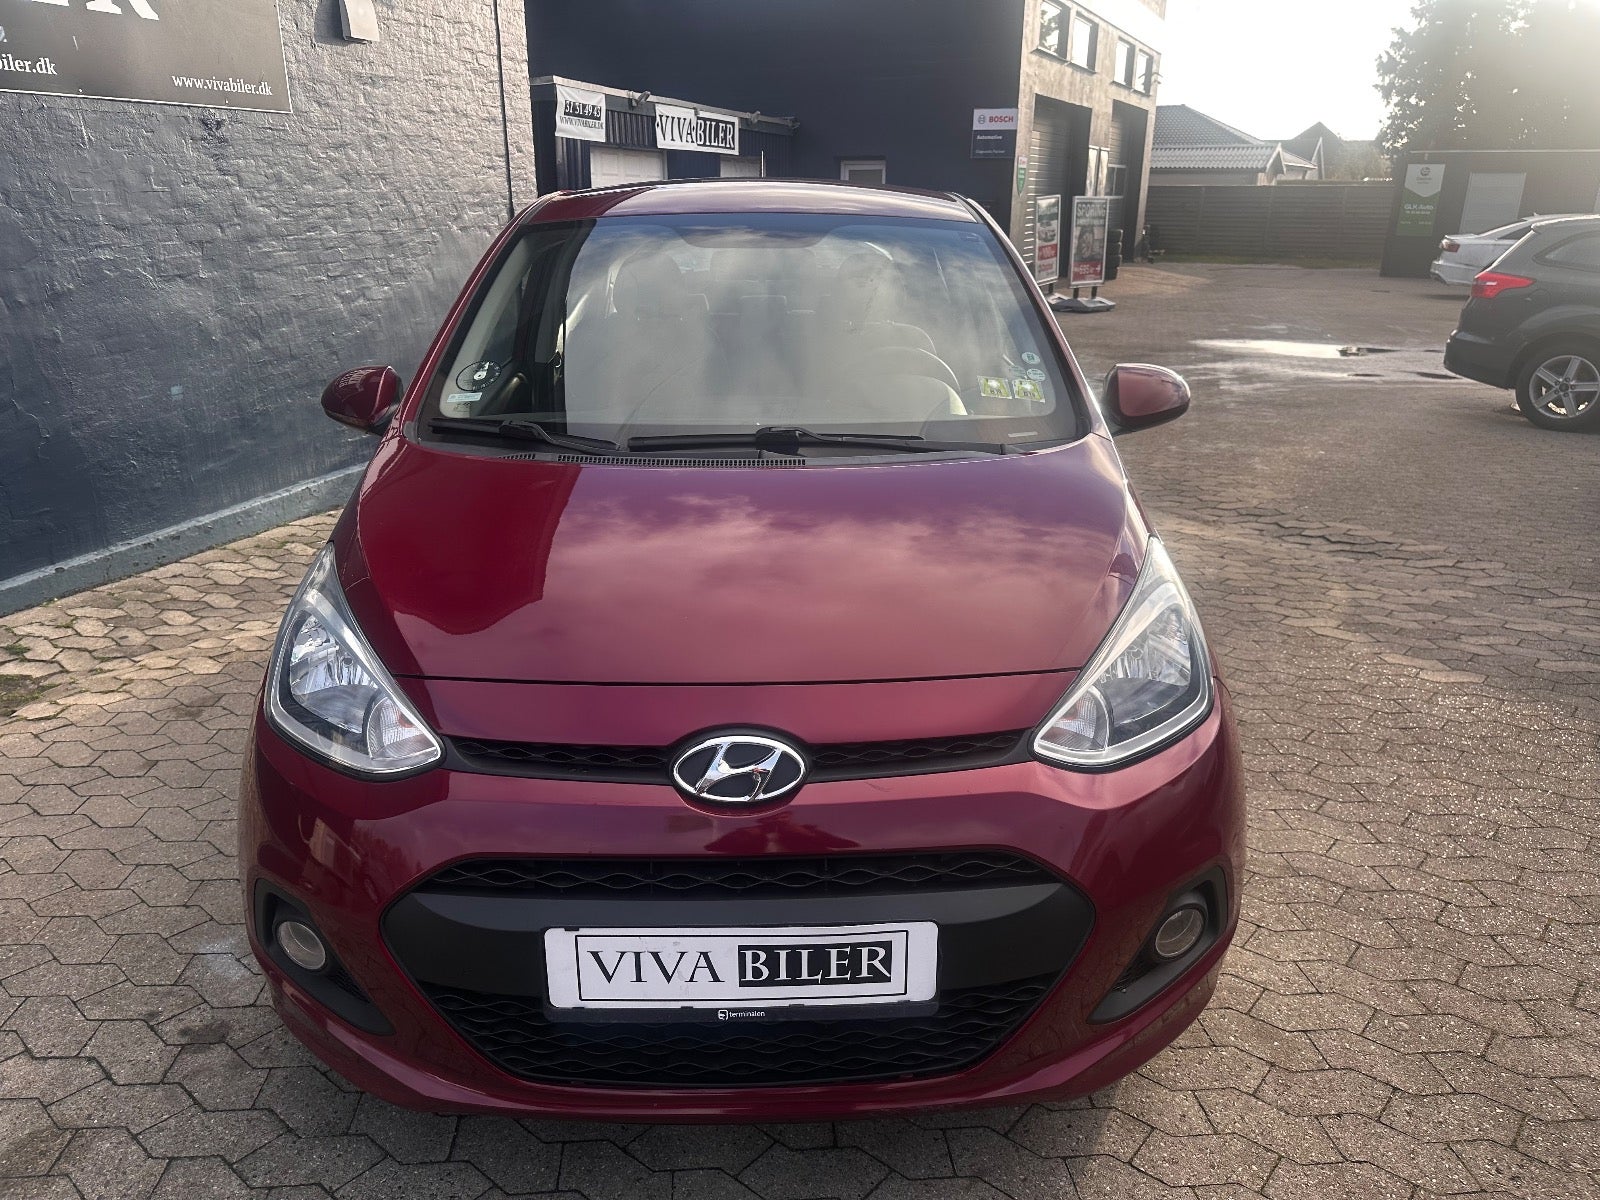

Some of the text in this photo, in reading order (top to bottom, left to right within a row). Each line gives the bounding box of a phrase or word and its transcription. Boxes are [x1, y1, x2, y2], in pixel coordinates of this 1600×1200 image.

[172, 76, 272, 96] www.vivabiler.dk
[989, 115, 1014, 123] BOSCH
[659, 114, 734, 148] VIVA BILER
[587, 946, 891, 984] VIVA BILER
[729, 1010, 766, 1018] terminalen
